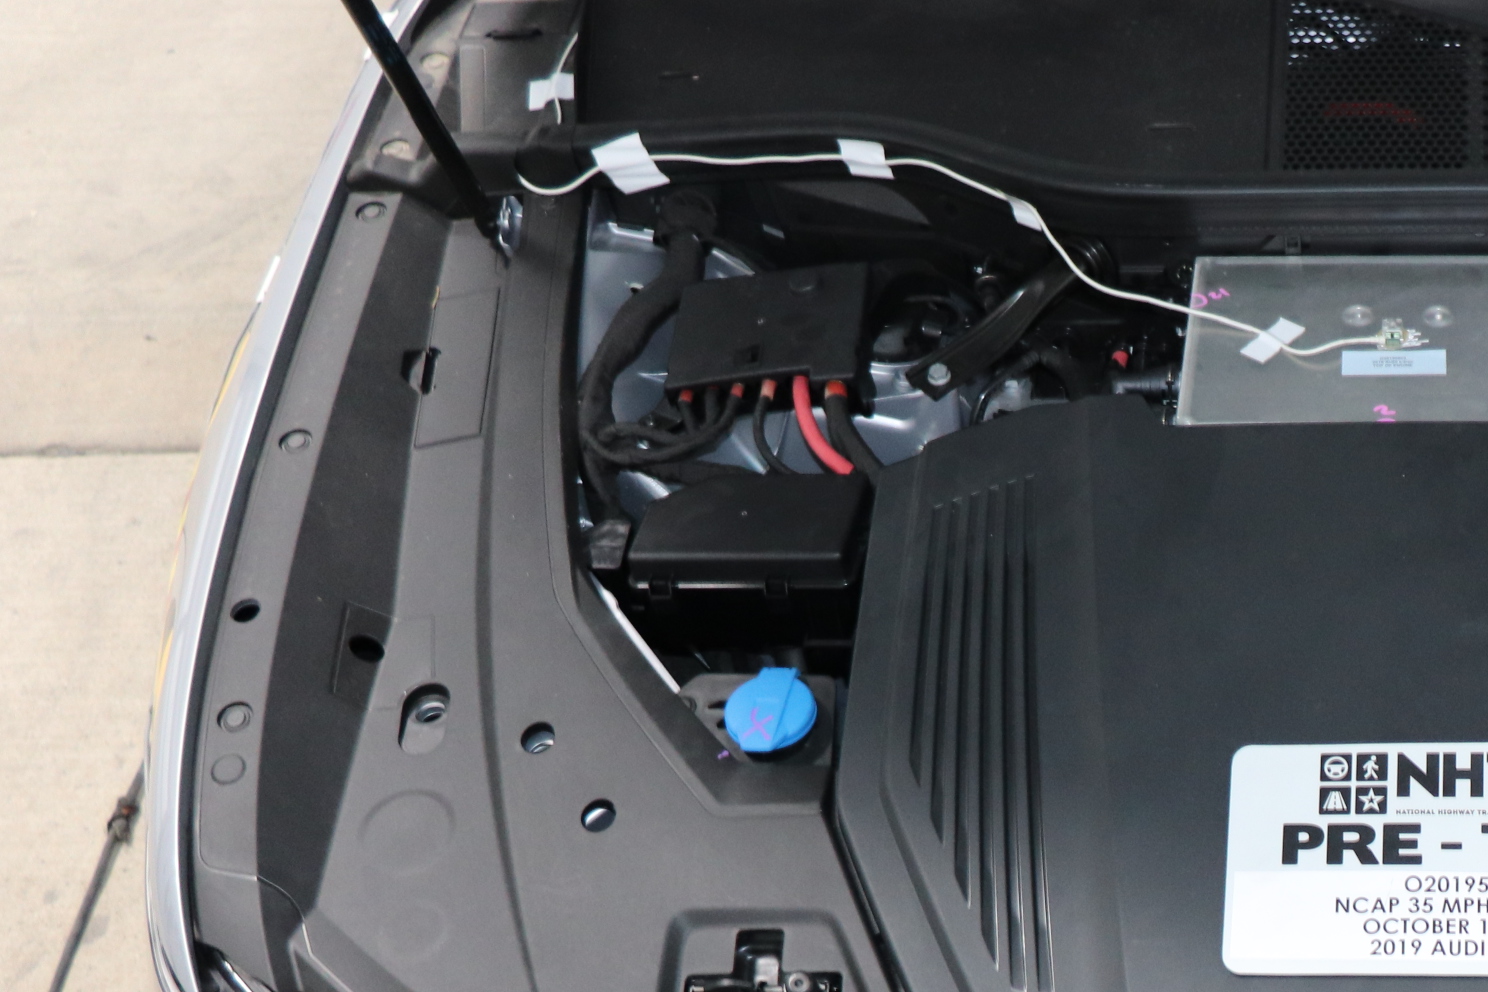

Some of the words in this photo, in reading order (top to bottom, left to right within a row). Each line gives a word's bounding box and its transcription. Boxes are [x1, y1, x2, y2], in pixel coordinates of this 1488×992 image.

[1282, 823, 1422, 865] PRE
[1335, 897, 1400, 914] NCAP
[1408, 897, 1434, 914] 35
[1362, 918, 1470, 935] OCTOBER
[1371, 939, 1422, 955] 2019
[1431, 940, 1485, 956] AUDI
